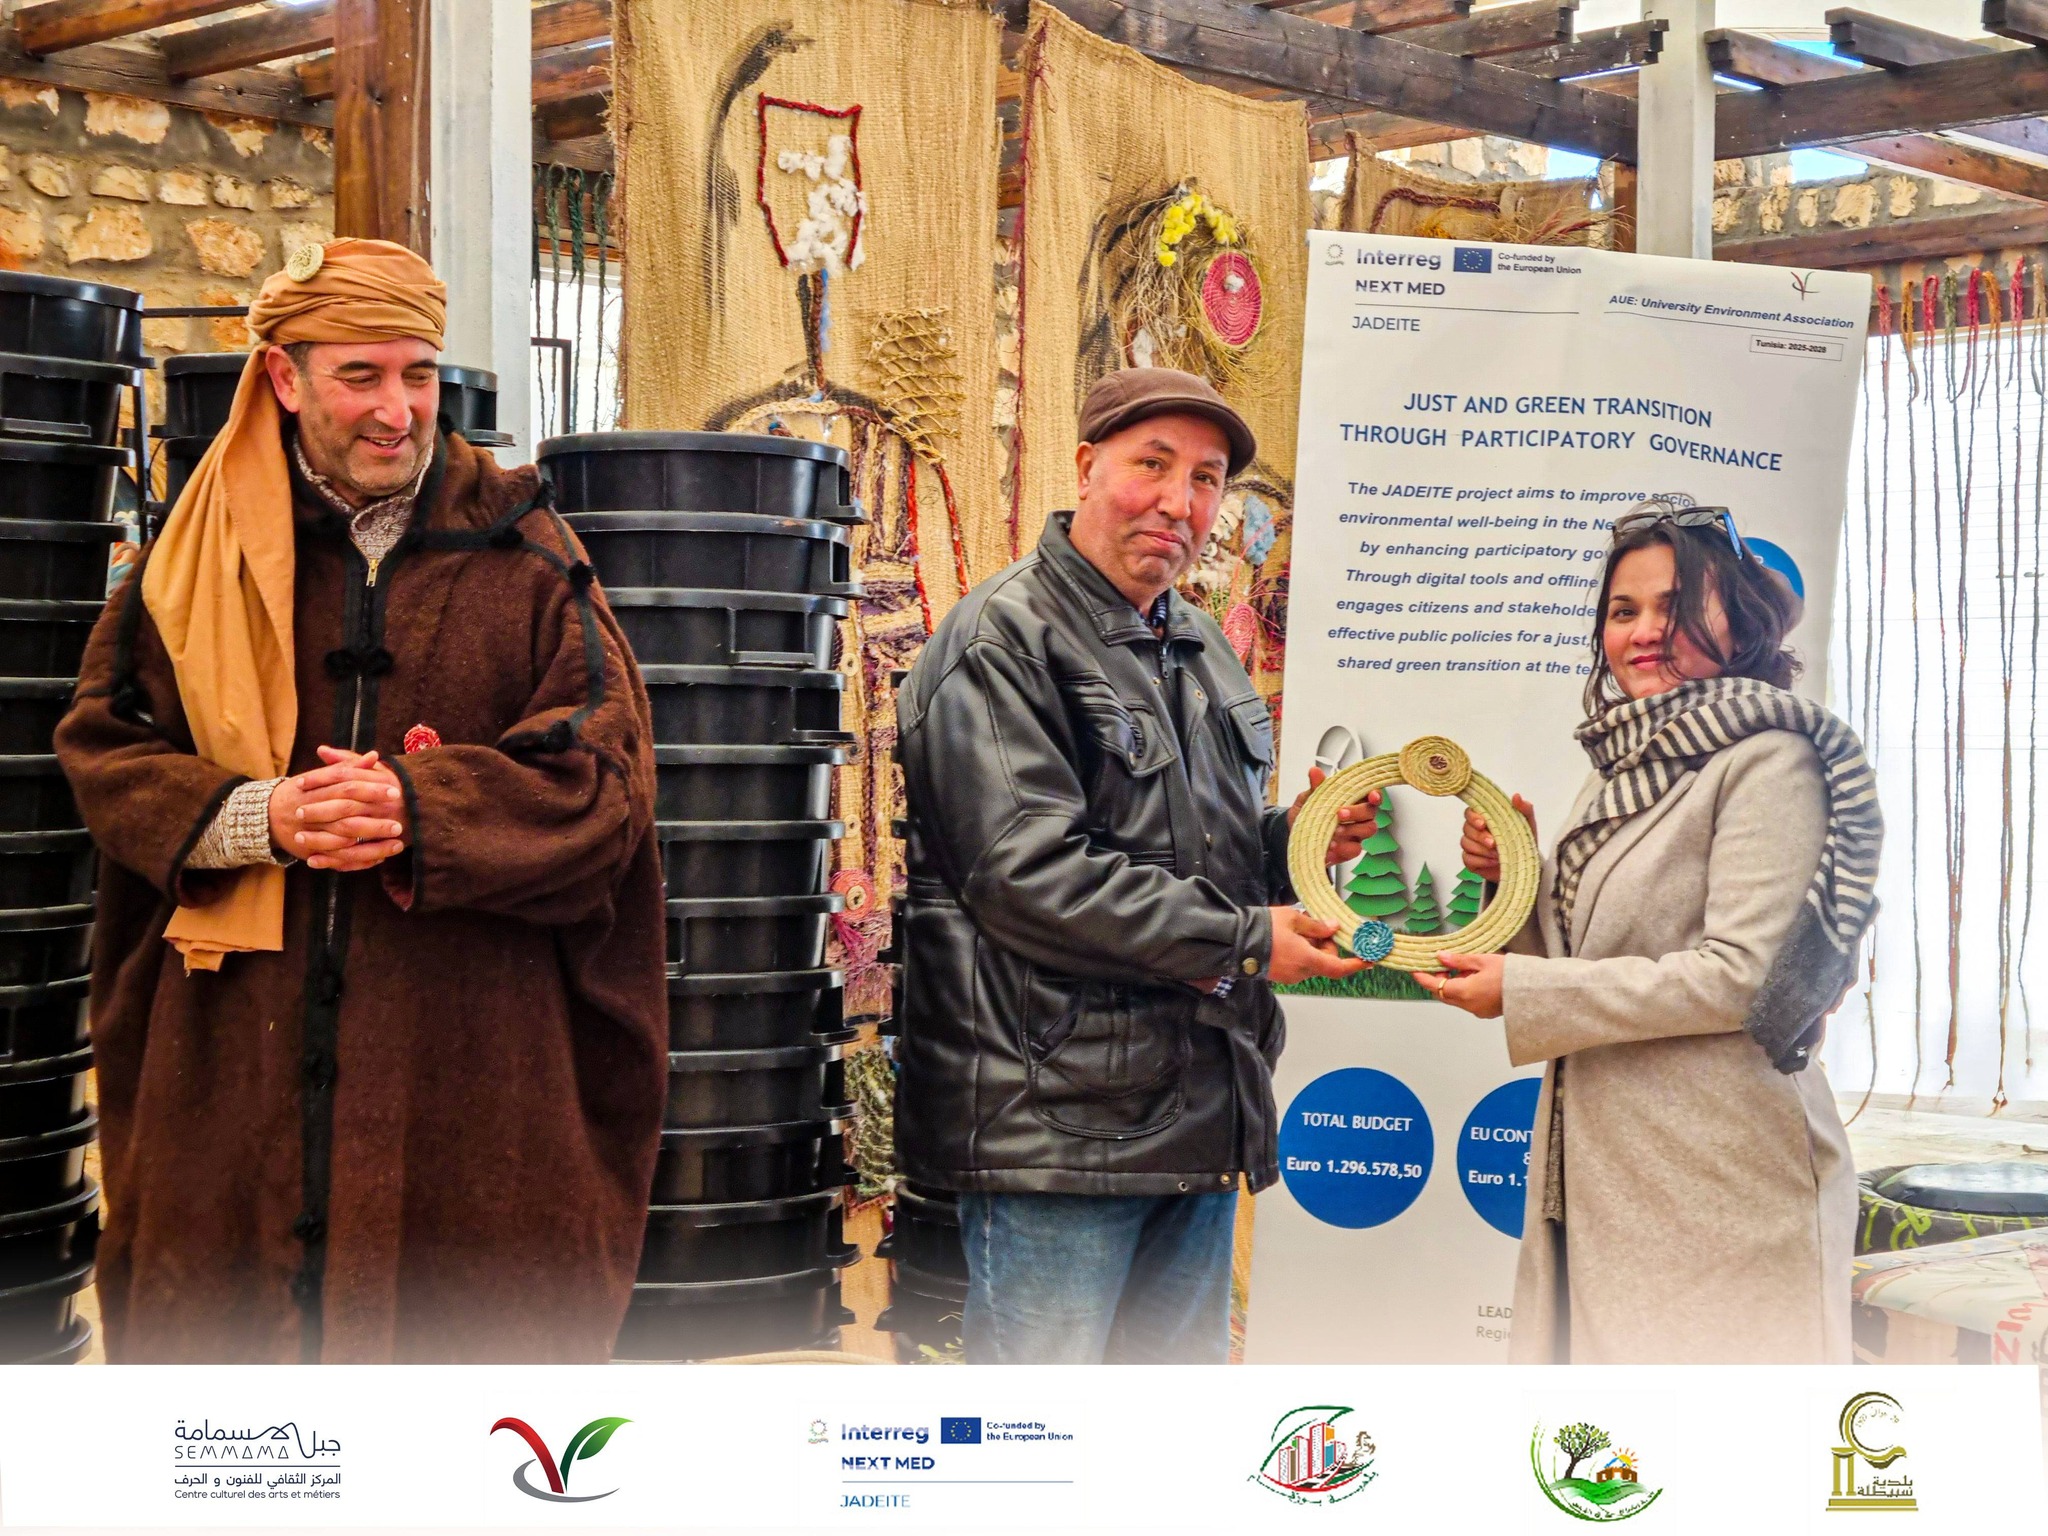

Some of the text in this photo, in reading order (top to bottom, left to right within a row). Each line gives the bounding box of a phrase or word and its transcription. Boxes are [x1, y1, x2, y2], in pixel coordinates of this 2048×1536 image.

[1357, 249, 1441, 270] Interreg
[1498, 252, 1555, 264] Co-funded by
[1498, 263, 1582, 275] the European Union
[1356, 280, 1445, 295] NEXT MED
[1609, 295, 1854, 329] AUE: University Environment Association
[1352, 316, 1421, 332] JADEITE
[1755, 339, 1827, 353] Tunisia: 2025-2028
[1403, 393, 1712, 428] JUST AND GREEN TRANSITION
[1340, 423, 1783, 471] THROUGH PARTICIPATORY GOVERNANCE
[1348, 482, 1378, 496] The
[1382, 484, 1453, 499] JADEITE
[1456, 487, 1513, 501] project
[1517, 487, 1555, 499] aims
[1560, 488, 1575, 500] to
[1580, 490, 1646, 504] improve
[1339, 513, 1614, 531] environmental well-being in the Ne
[1360, 541, 1380, 556] by
[1386, 543, 1469, 559] enhancing
[1474, 543, 1578, 560] participatory
[1346, 569, 1599, 588] Through digital tools and offline
[1336, 600, 1597, 617] engages citizens and stakeholde
[1328, 627, 1591, 647] effective public policies for a just,
[1337, 656, 1591, 675] shared green transition at the te
[1301, 1112, 1413, 1132] TOTAL BUDGET
[1470, 1127, 1535, 1143] EU CONT
[1286, 1156, 1423, 1180] Euro 1.296.578,50
[1468, 1170, 1504, 1185] Euro
[1478, 1305, 1513, 1319] LEAD
